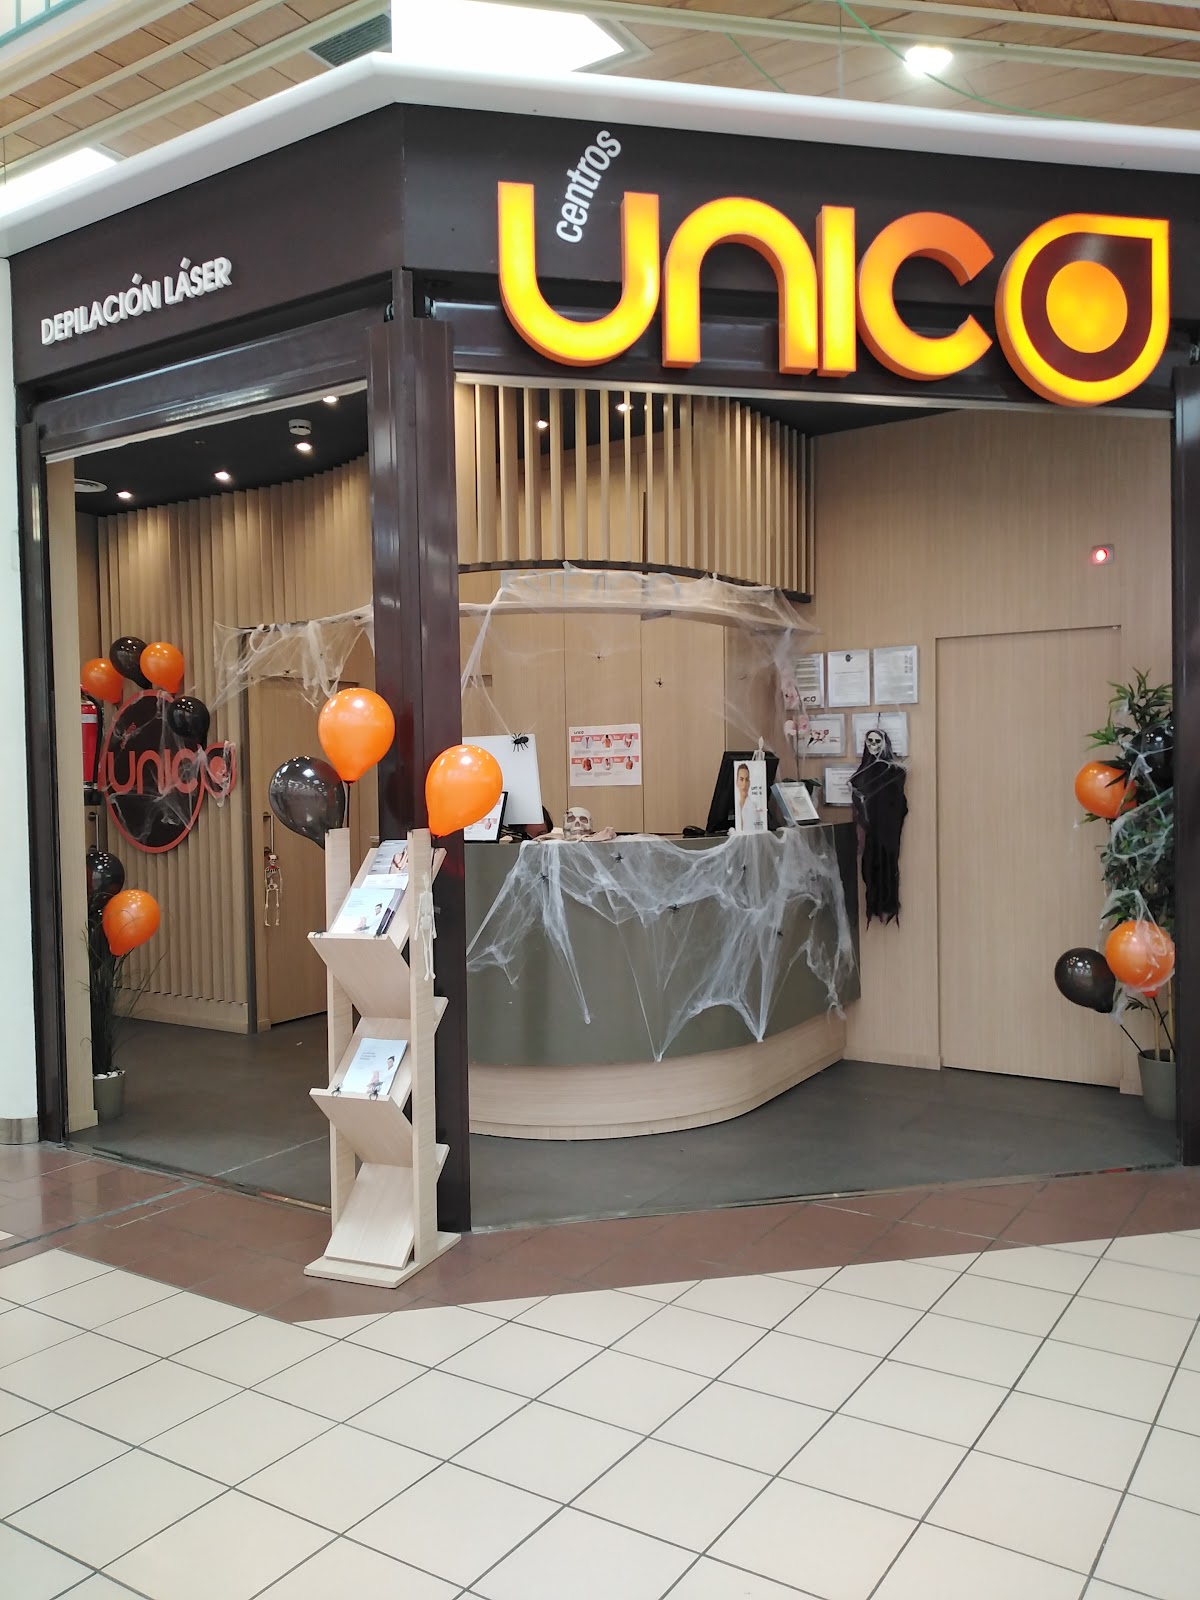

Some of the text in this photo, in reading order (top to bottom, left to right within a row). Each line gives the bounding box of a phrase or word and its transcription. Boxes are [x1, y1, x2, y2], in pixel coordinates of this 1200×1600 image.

[556, 130, 622, 244] centros
[40, 256, 233, 346] DEPILACIÓN LÁSER
